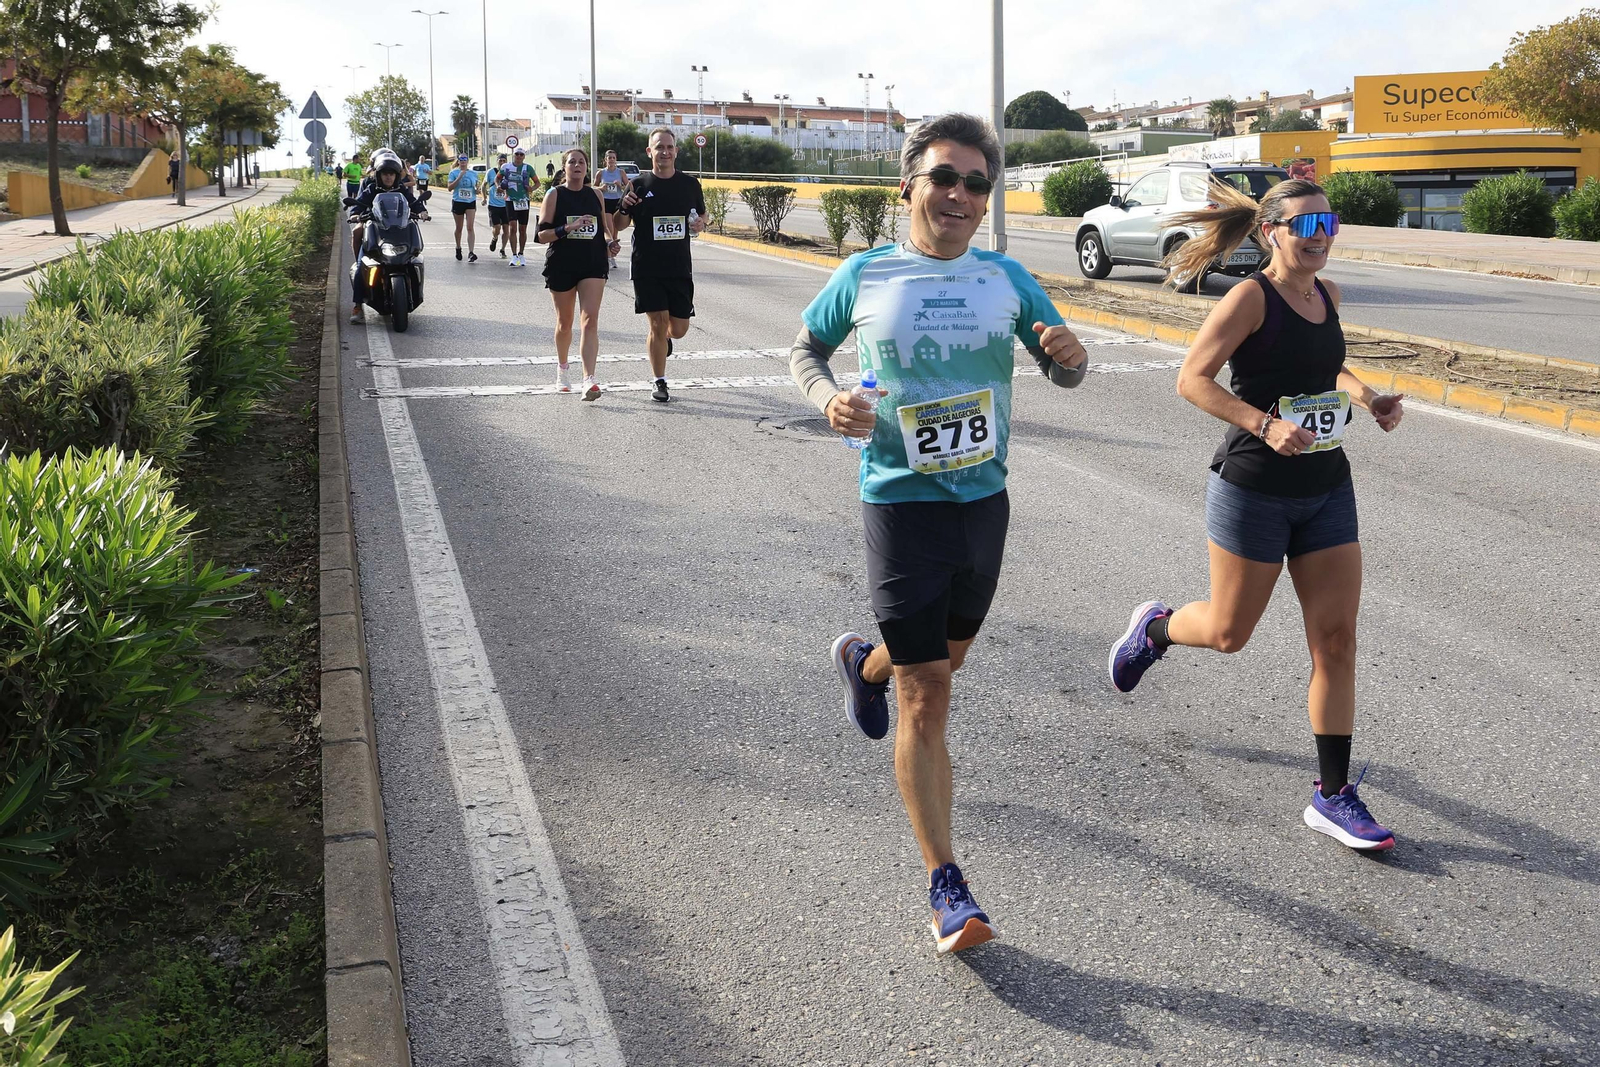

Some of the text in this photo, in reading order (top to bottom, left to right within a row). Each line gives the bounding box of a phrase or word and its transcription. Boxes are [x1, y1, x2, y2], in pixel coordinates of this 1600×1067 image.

[1383, 107, 1519, 124] Tu Super Económico
[575, 224, 594, 233] 38
[657, 223, 682, 233] 464
[1244, 254, 1257, 262] DNZ
[931, 310, 977, 319] CaixaBank
[940, 323, 950, 331] de
[951, 323, 979, 332] Málaga
[1290, 398, 1318, 407] CARRERA
[1318, 396, 1341, 404] URBANA
[915, 400, 980, 420] CARRERA URBANA
[1292, 406, 1312, 414] CIUDAD
[1318, 402, 1342, 411] ALGECIRAS
[917, 407, 981, 427] CIUDAD DE ALGECIRAS
[1300, 410, 1336, 434] 49
[915, 414, 988, 455] 278
